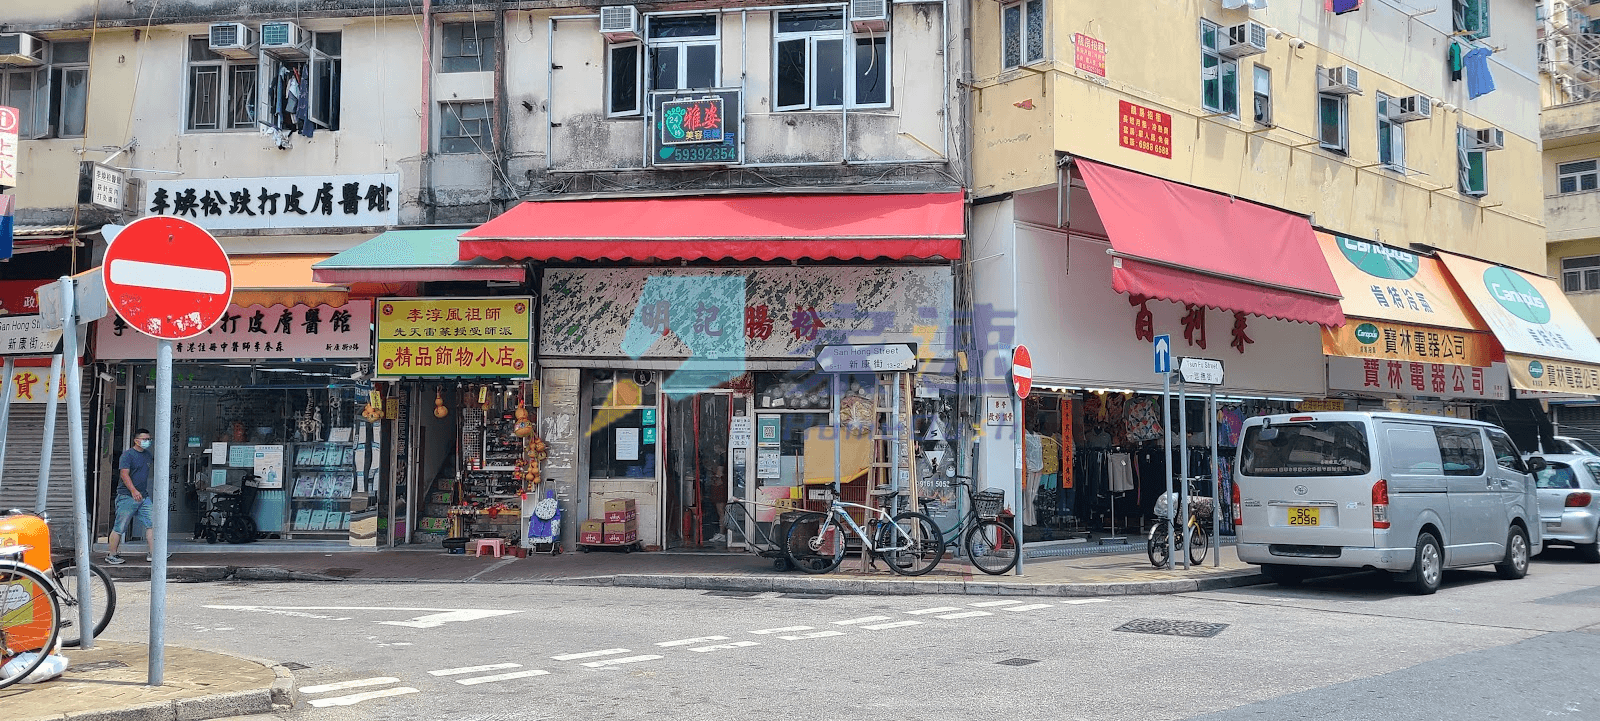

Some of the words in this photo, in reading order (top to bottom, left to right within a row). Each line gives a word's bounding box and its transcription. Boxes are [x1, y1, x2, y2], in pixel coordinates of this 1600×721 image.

[674, 148, 735, 160] 59392354
[12, 320, 30, 332] Hong
[641, 300, 827, 341] 明記腸粉
[8, 336, 38, 350] 新康街
[1383, 328, 1466, 359] 寶林電器公司
[394, 346, 515, 367] 精品飾物小店
[833, 348, 848, 356] San
[851, 348, 870, 356] Hong
[849, 359, 882, 369] 新康街
[1363, 359, 1484, 396] 寶林電器公司
[1297, 508, 1310, 517] SC
[1290, 516, 1317, 525] 2098
